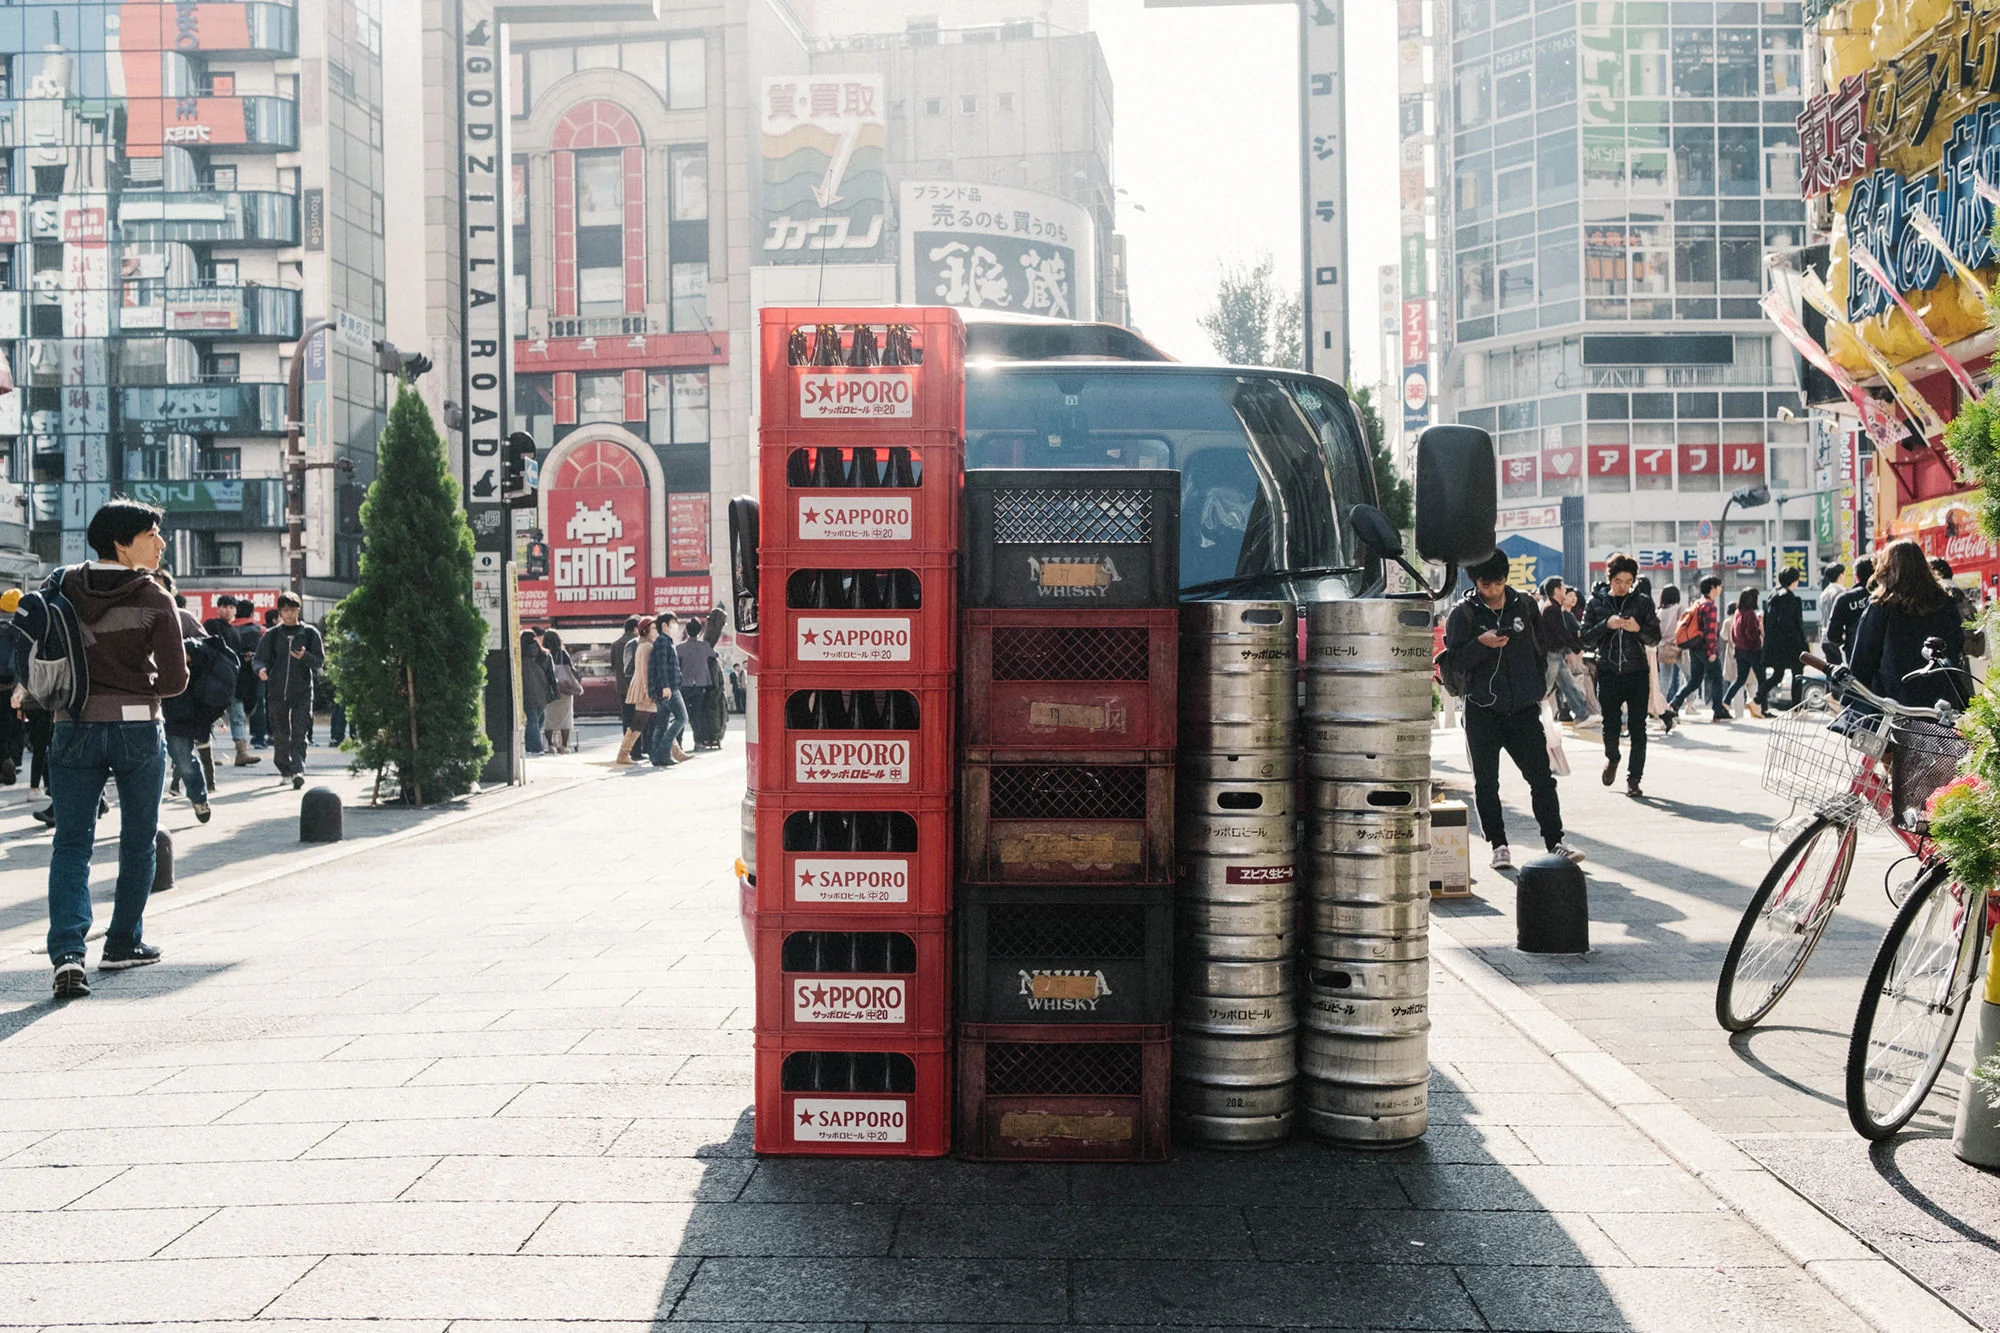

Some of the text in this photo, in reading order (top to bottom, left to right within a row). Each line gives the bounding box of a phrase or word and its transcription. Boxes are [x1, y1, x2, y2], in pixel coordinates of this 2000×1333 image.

[466, 57, 497, 309] GODZILLA
[913, 186, 982, 202] ブランド品
[931, 204, 1068, 242] 売るのも買うのも
[1407, 303, 1424, 361] アイフル
[471, 339, 499, 457] ROAD
[818, 406, 871, 415] サッポロビール
[1598, 449, 1757, 473] アイフル
[823, 508, 910, 526] SAPPORO
[1820, 495, 1831, 538] レイク
[823, 529, 870, 538] サッポロビール
[554, 546, 637, 587] GAME
[589, 586, 637, 601] STATION
[1037, 584, 1110, 598] WHISKY
[822, 629, 908, 647] SAPPORO
[822, 651, 868, 659] サッポロビール
[800, 743, 906, 766] SAPPORO
[818, 767, 886, 779] サッポロビール
[819, 871, 905, 888] SAPPORO
[819, 892, 866, 900] サッポロビール
[1027, 998, 1100, 1011] WHISKY
[812, 1010, 864, 1020] サッポロビール
[1208, 1008, 1272, 1021] サッポロビール
[818, 1110, 904, 1128] SAPPORO
[818, 1132, 865, 1140] サッポロビール
